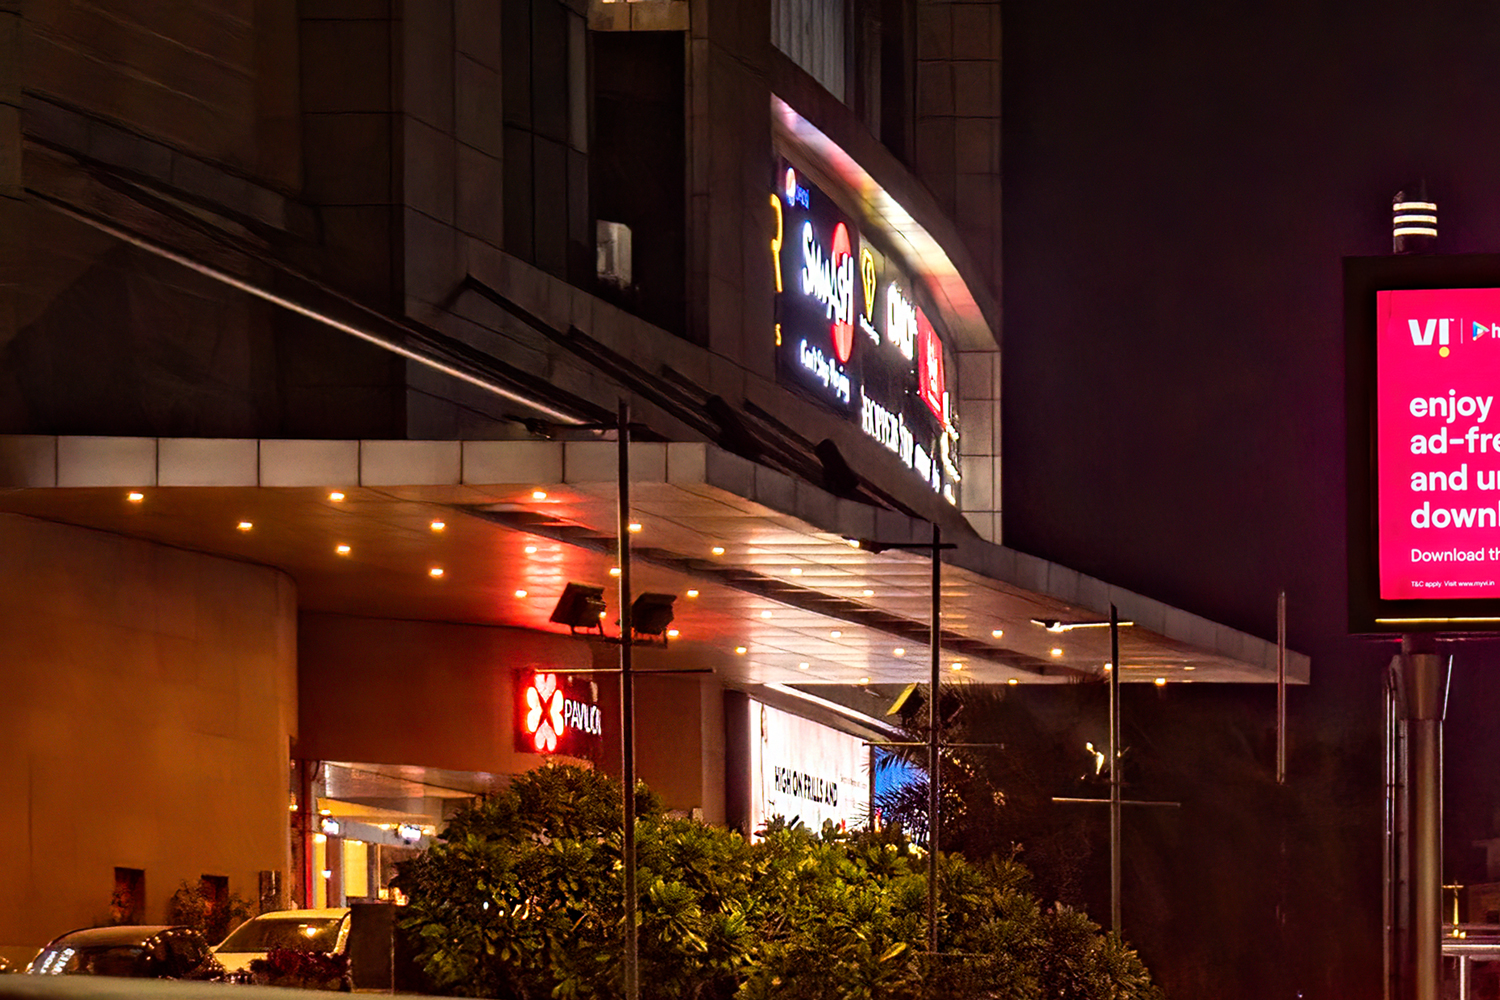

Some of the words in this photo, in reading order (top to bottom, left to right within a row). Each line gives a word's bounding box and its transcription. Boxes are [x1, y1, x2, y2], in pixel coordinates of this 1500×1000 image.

[1409, 389, 1494, 424] enjoy
[1410, 463, 1468, 492] and
[1411, 548, 1485, 562] Download
[775, 766, 792, 795] HIGH
[793, 770, 804, 799] ON
[804, 773, 823, 804] FRILLS
[825, 780, 839, 807] AND
